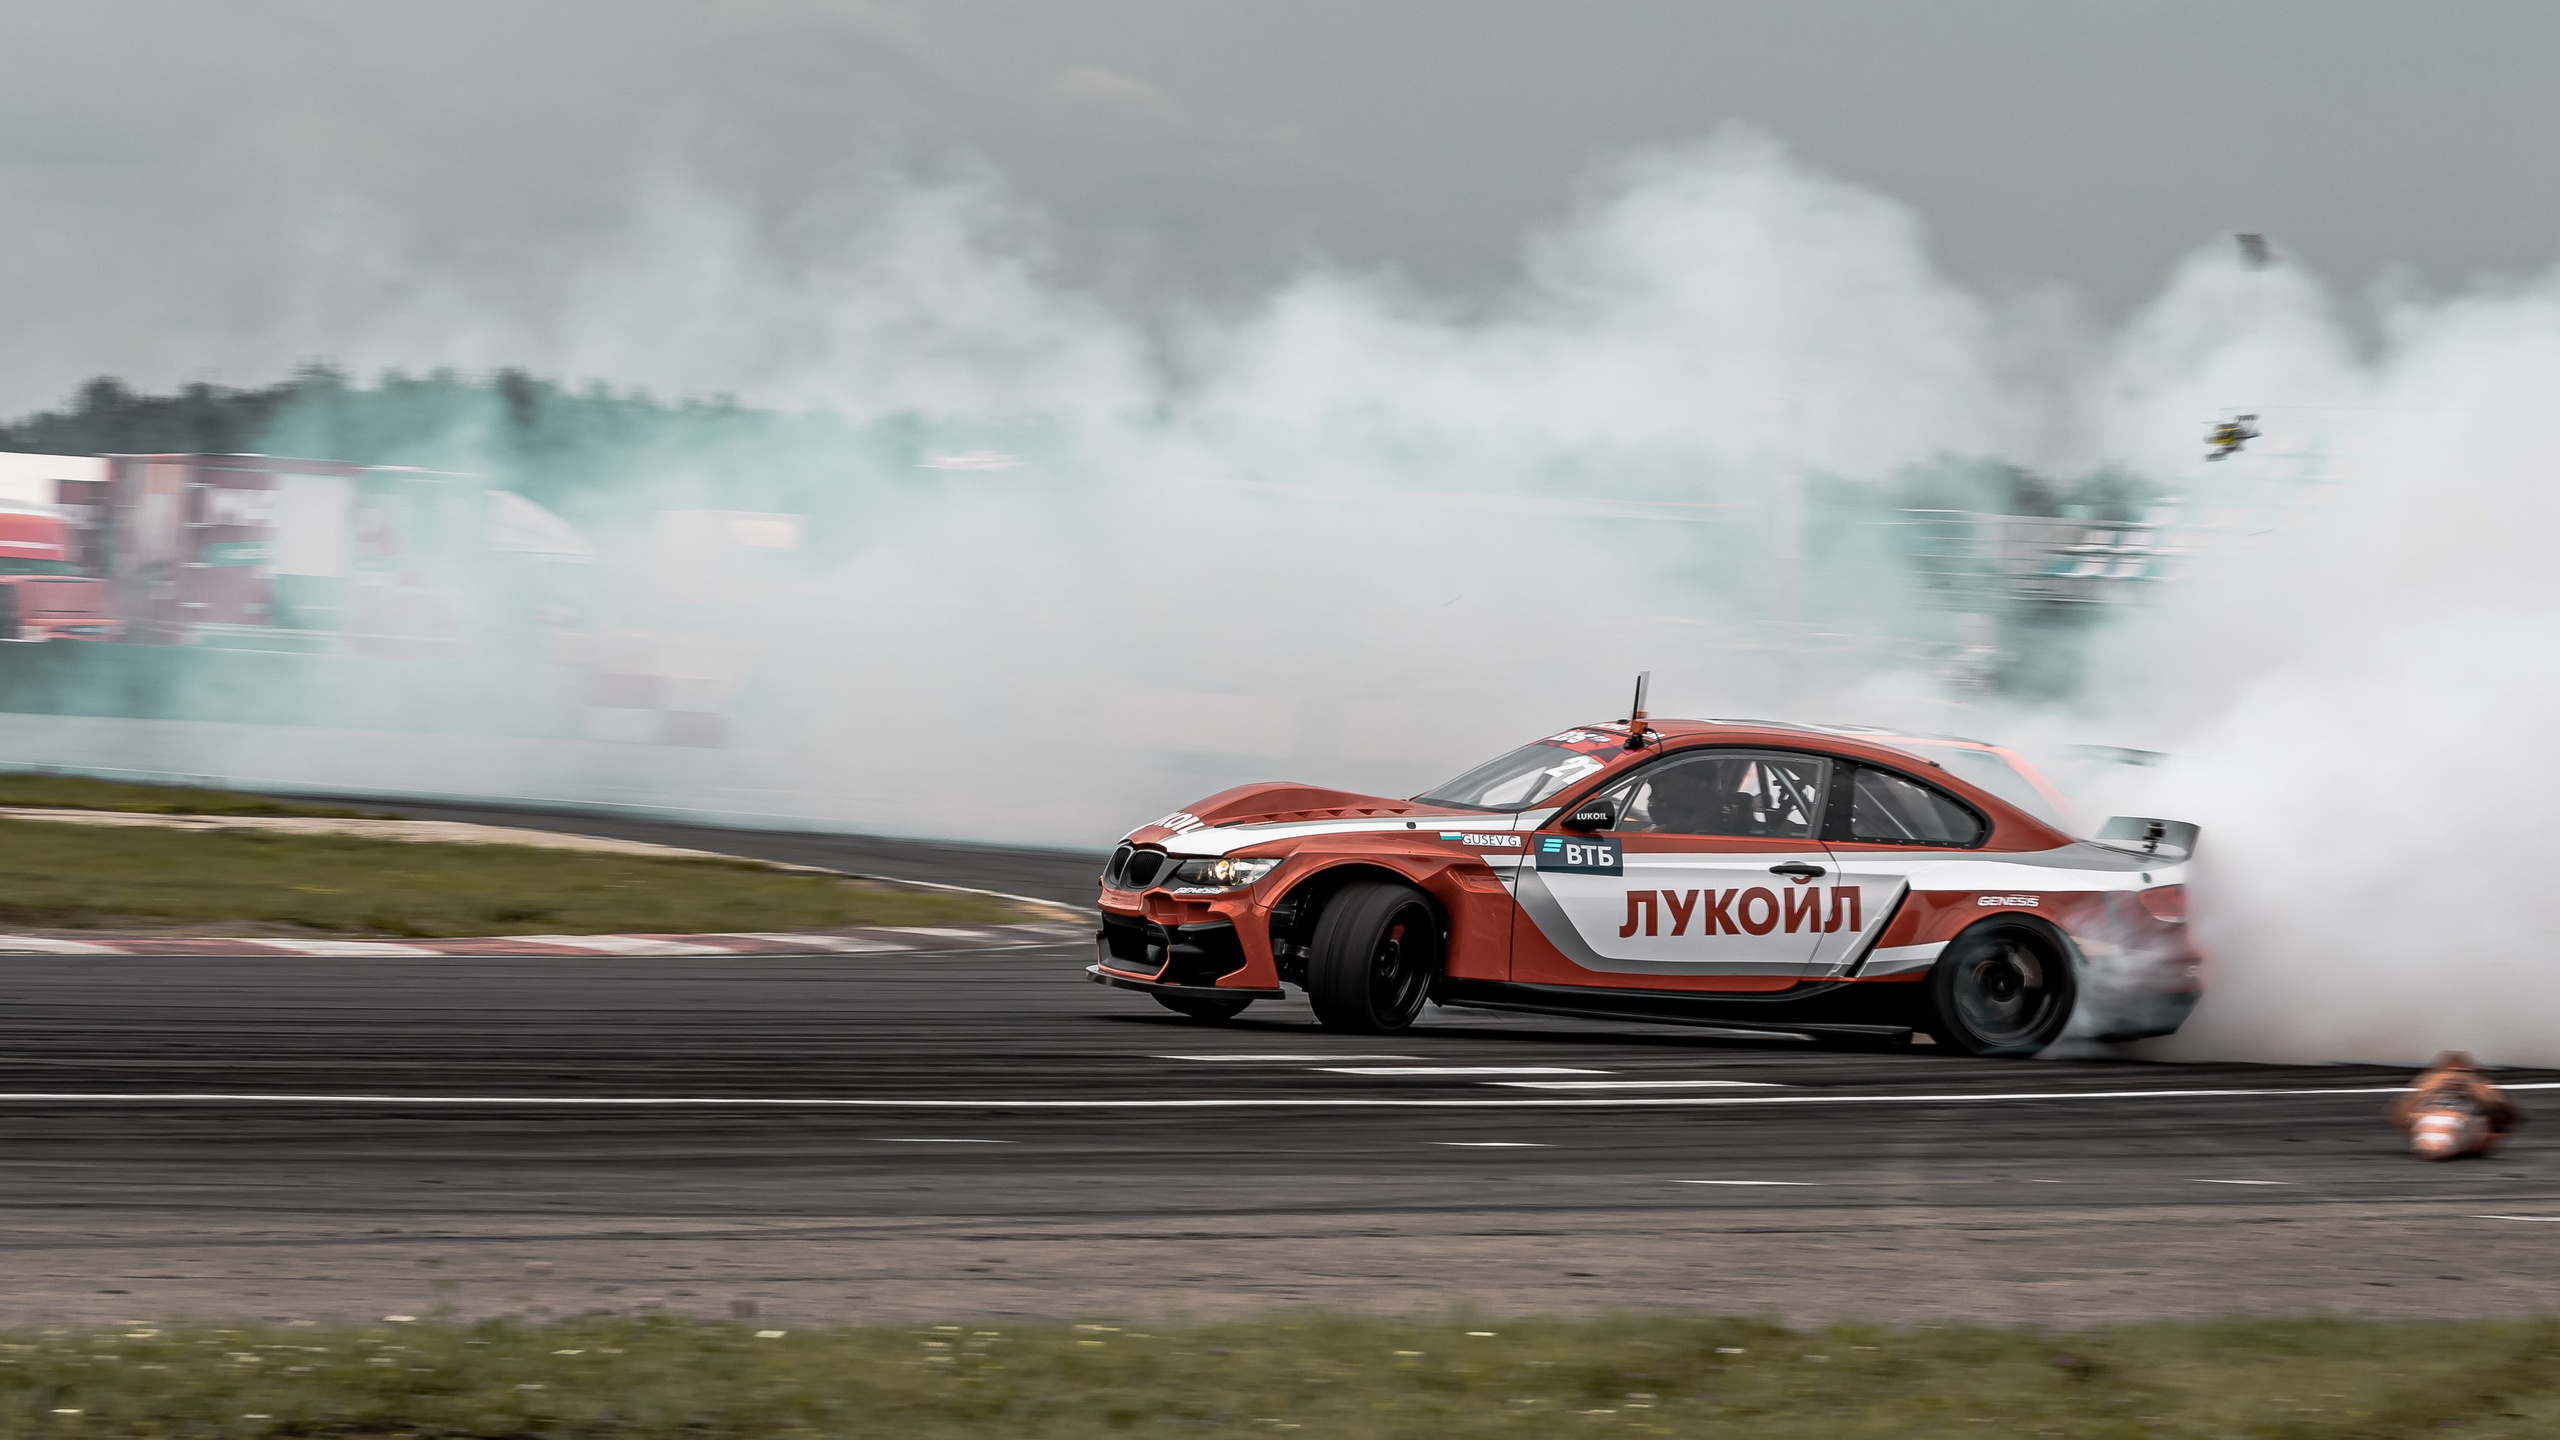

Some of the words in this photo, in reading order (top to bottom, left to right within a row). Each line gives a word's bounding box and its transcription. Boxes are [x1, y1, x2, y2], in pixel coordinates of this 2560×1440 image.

[1543, 755, 1605, 785] 21
[1576, 812, 1608, 820] LUKOIL
[1462, 834, 1504, 845] GUSEV
[1508, 835, 1521, 846] G.
[1566, 844, 1614, 867] ВТБ
[1619, 876, 1862, 938] ЛУКОЙЛ
[1976, 896, 2040, 908] GENESIS
